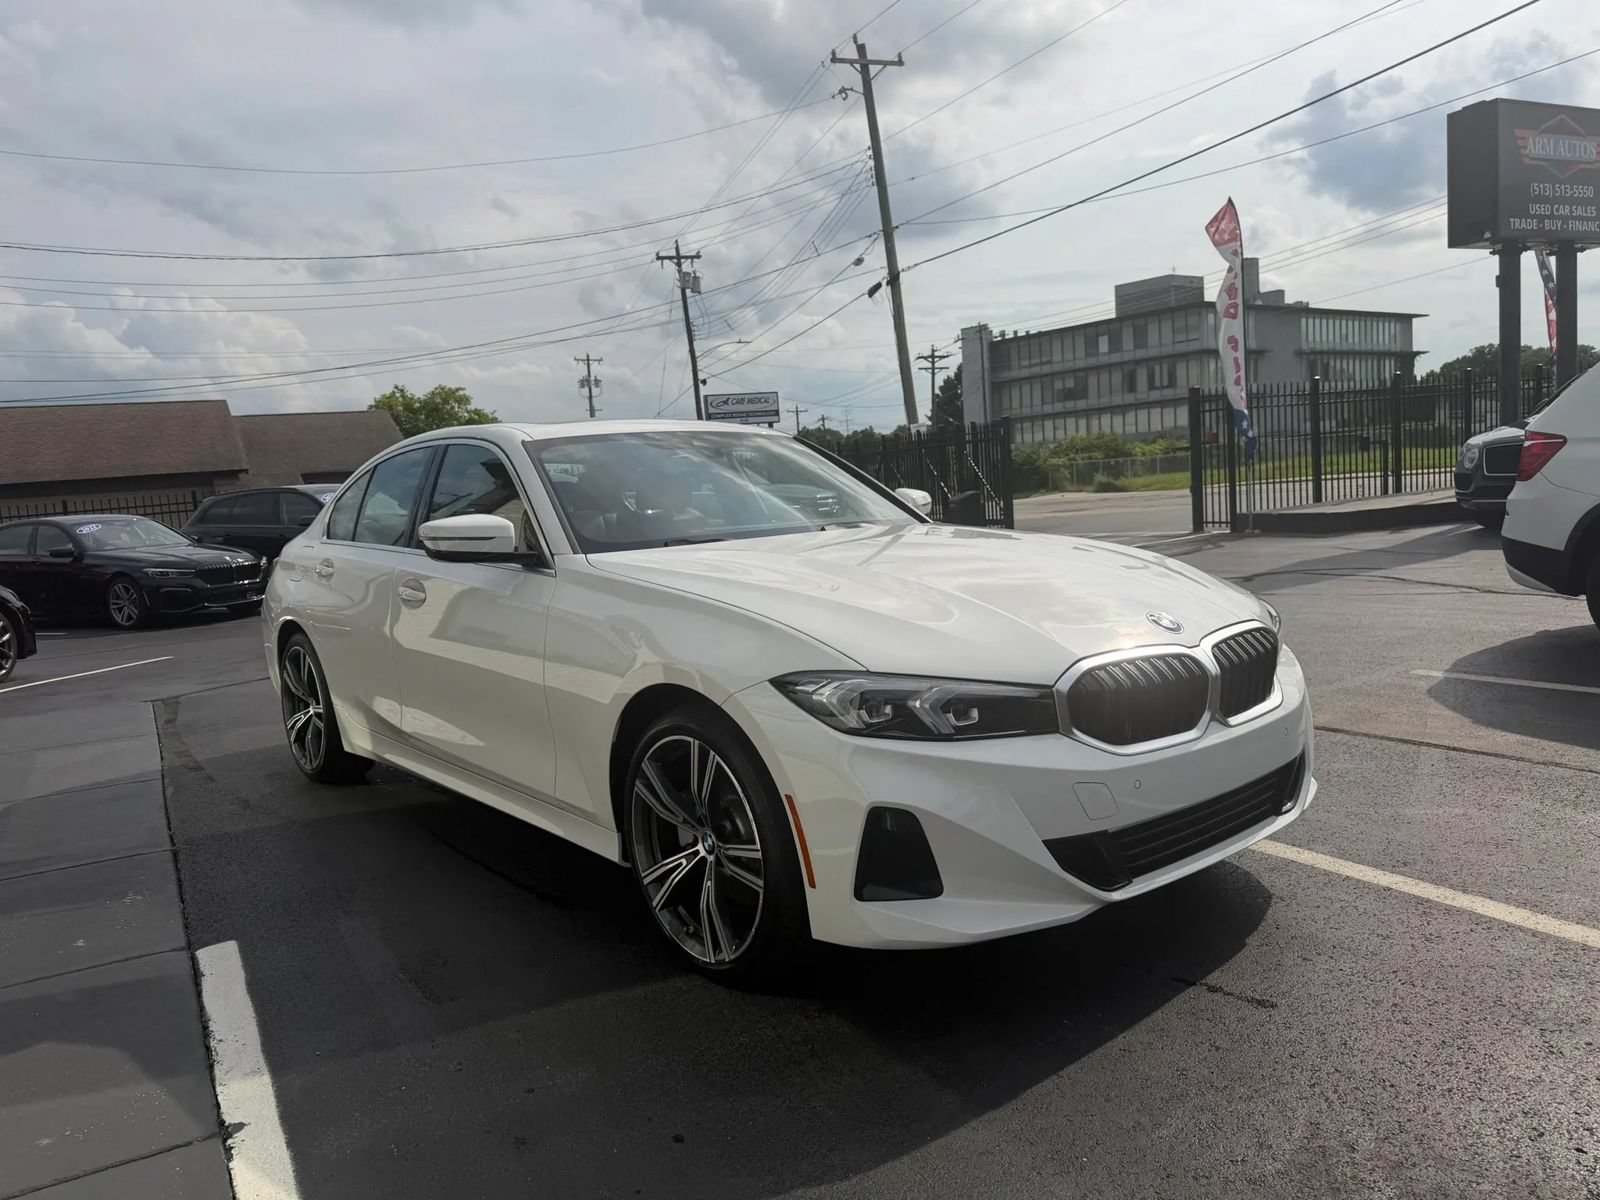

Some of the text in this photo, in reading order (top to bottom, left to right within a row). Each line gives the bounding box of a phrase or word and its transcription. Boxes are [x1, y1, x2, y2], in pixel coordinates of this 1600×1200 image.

[1527, 136, 1597, 160] ARM AUTOS
[1530, 183, 1594, 198] (513) 513-5550
[1529, 203, 1597, 217] USED CAR SALES
[1509, 218, 1538, 230] TRADE
[1544, 219, 1562, 231] BUY
[731, 396, 770, 406] CARE MEDICAL
